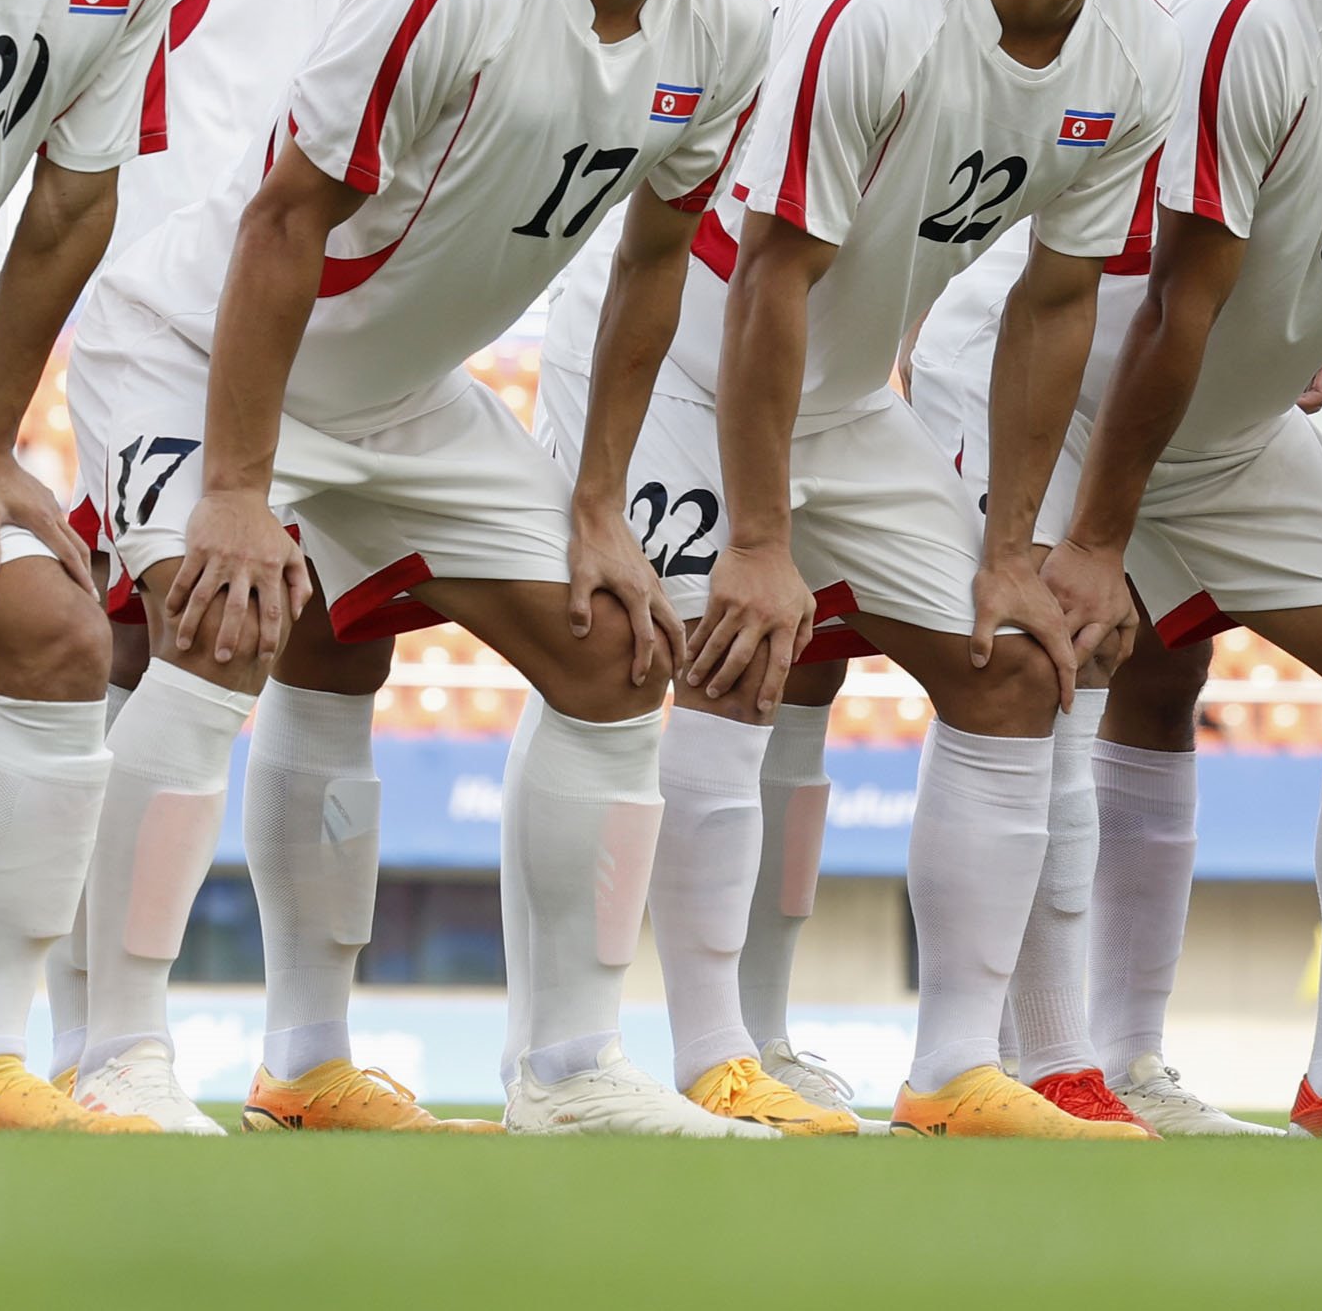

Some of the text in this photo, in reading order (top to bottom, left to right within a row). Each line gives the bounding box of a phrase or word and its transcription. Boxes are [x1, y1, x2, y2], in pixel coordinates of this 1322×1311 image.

[511, 142, 638, 238] 17
[918, 149, 1028, 243] 22
[115, 434, 202, 537] 17
[630, 481, 719, 578] 22
